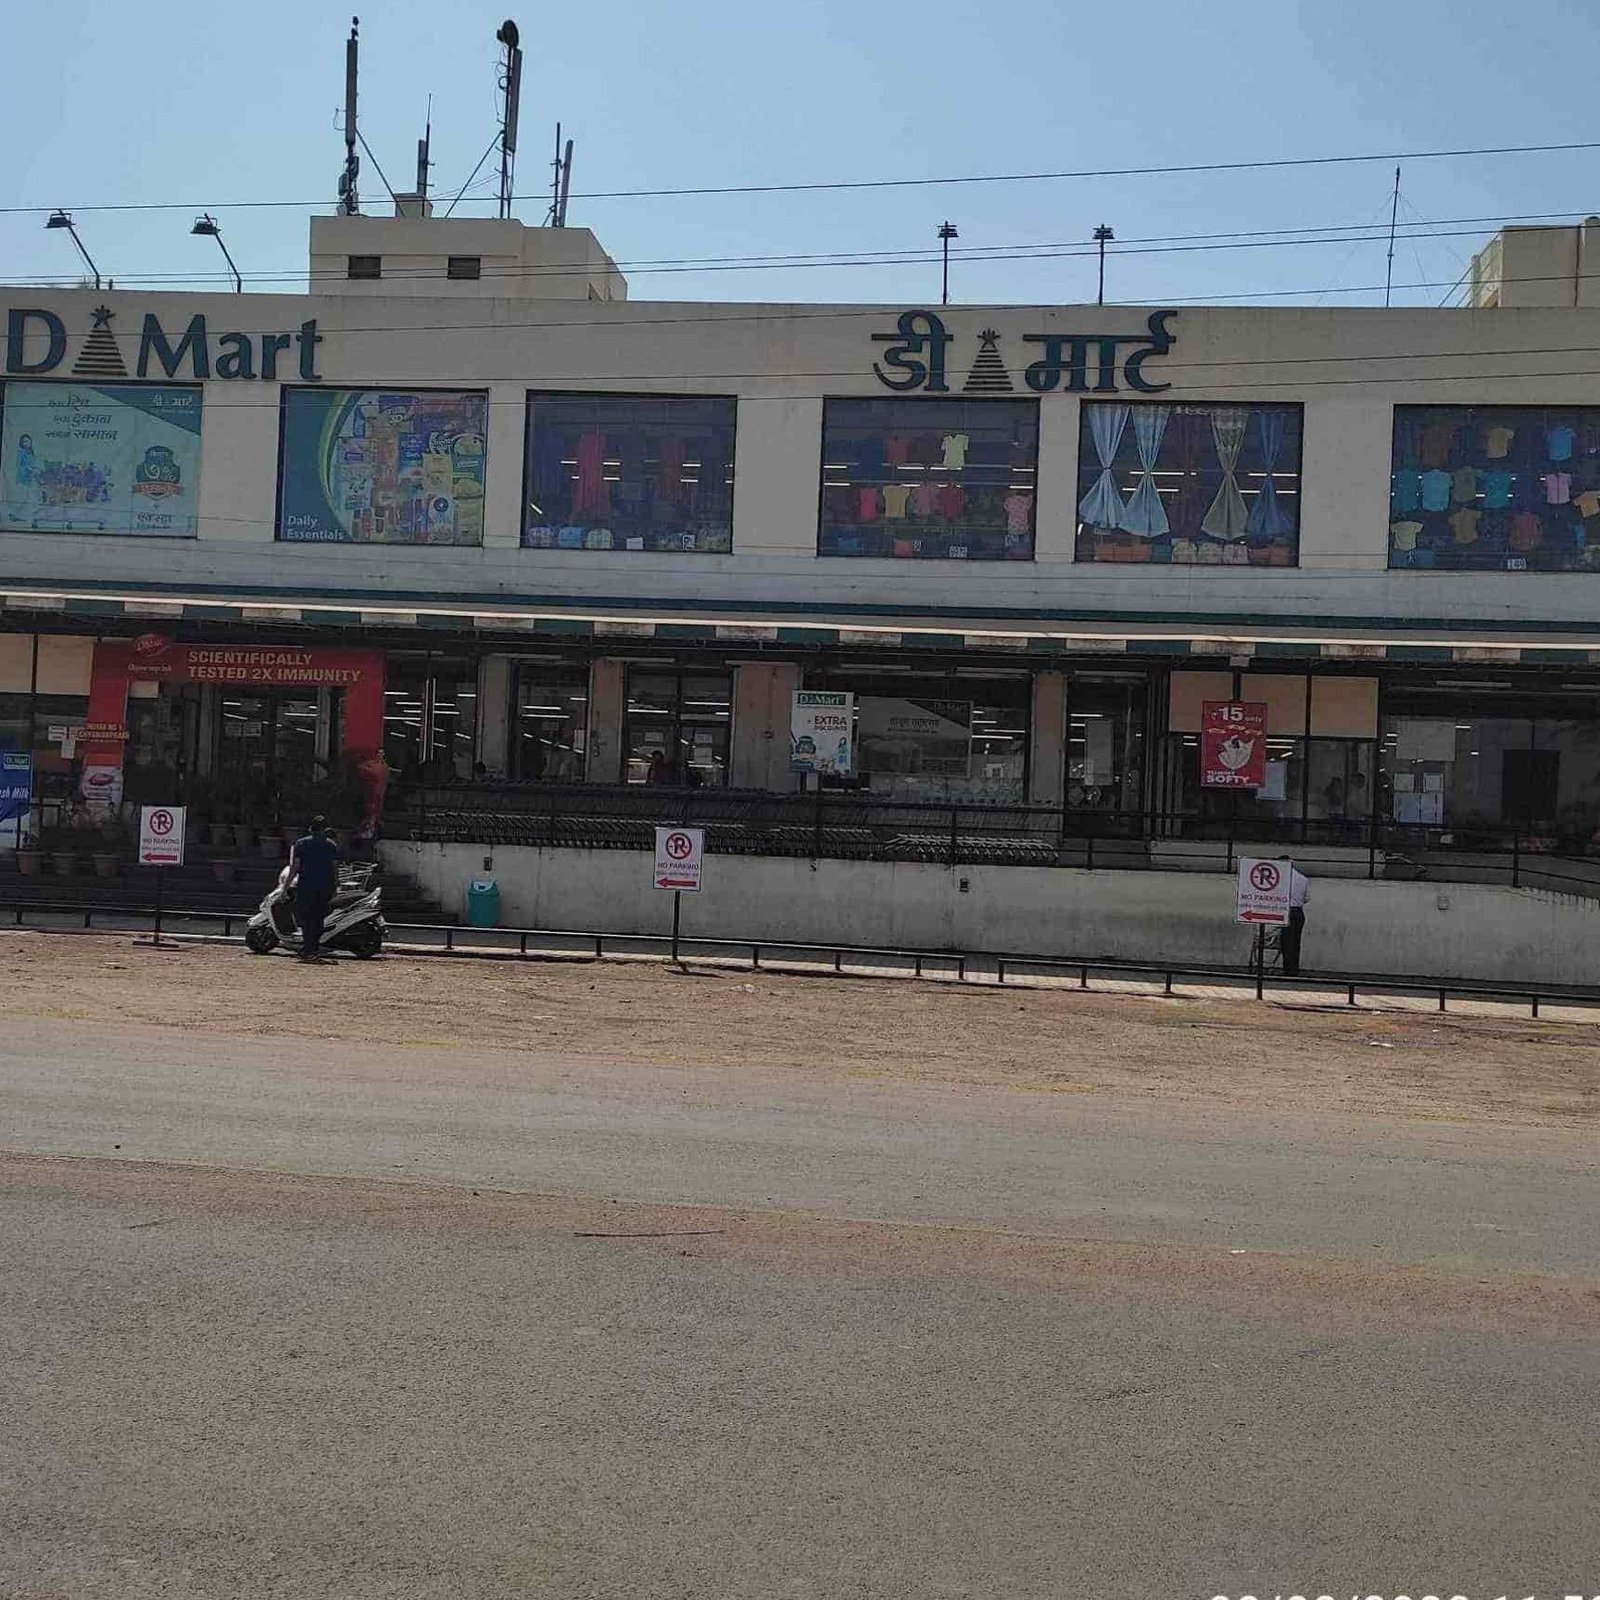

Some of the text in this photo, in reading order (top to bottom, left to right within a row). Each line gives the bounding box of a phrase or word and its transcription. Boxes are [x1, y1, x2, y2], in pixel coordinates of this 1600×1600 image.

[6, 308, 323, 380] D Mart
[871, 310, 1177, 393] डी मार्ट
[288, 515, 318, 528] Daily
[286, 528, 345, 541] Essentials
[188, 651, 313, 667] SCIENTIFICALLY
[188, 666, 362, 683] TESTED 2X IMMUNITY
[814, 715, 847, 725] EXTRA
[1206, 774, 1251, 785] SOFTY
